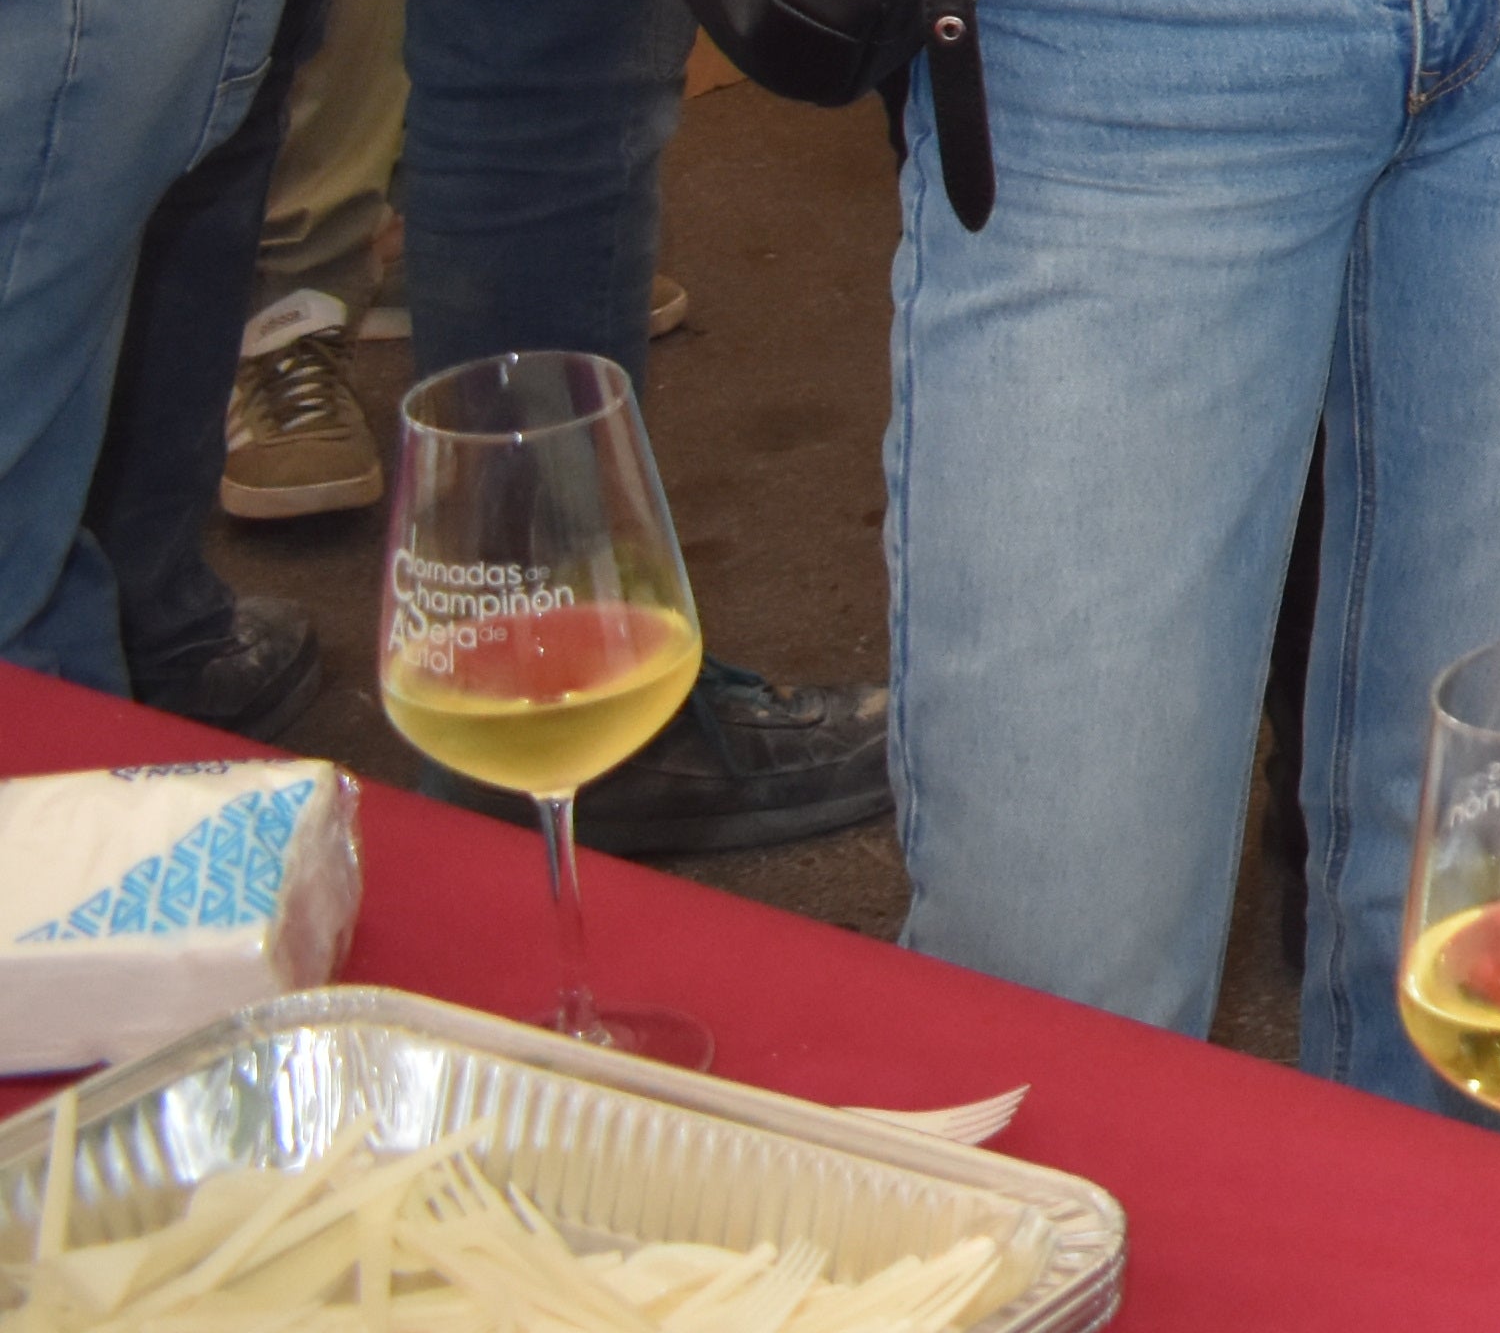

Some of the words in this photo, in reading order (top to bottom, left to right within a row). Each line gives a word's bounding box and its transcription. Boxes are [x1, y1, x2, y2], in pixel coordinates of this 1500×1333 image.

[392, 548, 575, 621] Champiñón
[407, 522, 523, 585] Jornadas
[525, 564, 551, 582] de
[408, 601, 478, 648] Seta
[479, 625, 509, 642] de
